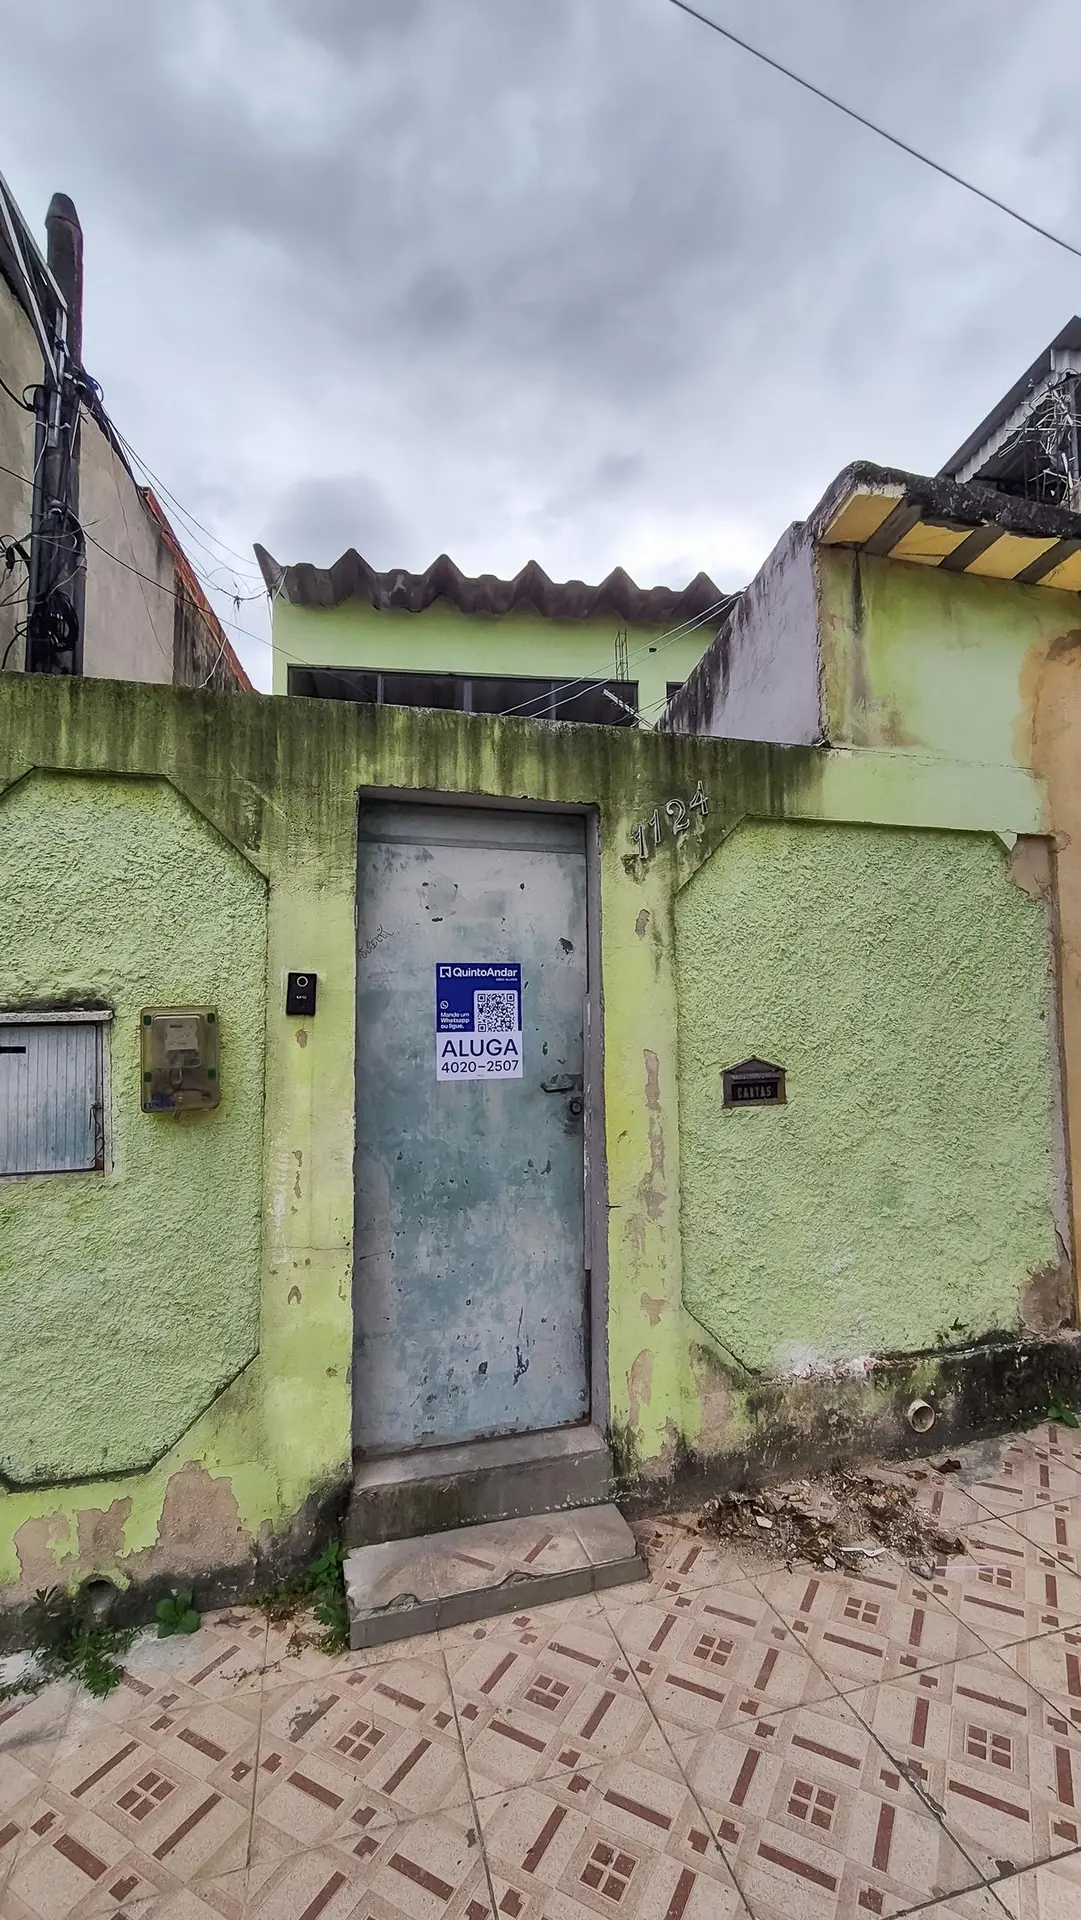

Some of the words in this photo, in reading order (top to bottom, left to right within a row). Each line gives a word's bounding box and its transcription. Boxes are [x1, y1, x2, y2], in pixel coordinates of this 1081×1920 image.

[633, 780, 709, 859] 1124
[453, 967, 517, 977] QuintoAndar
[442, 1039, 519, 1057] ALUGA
[441, 1060, 519, 1073] 4020-2507
